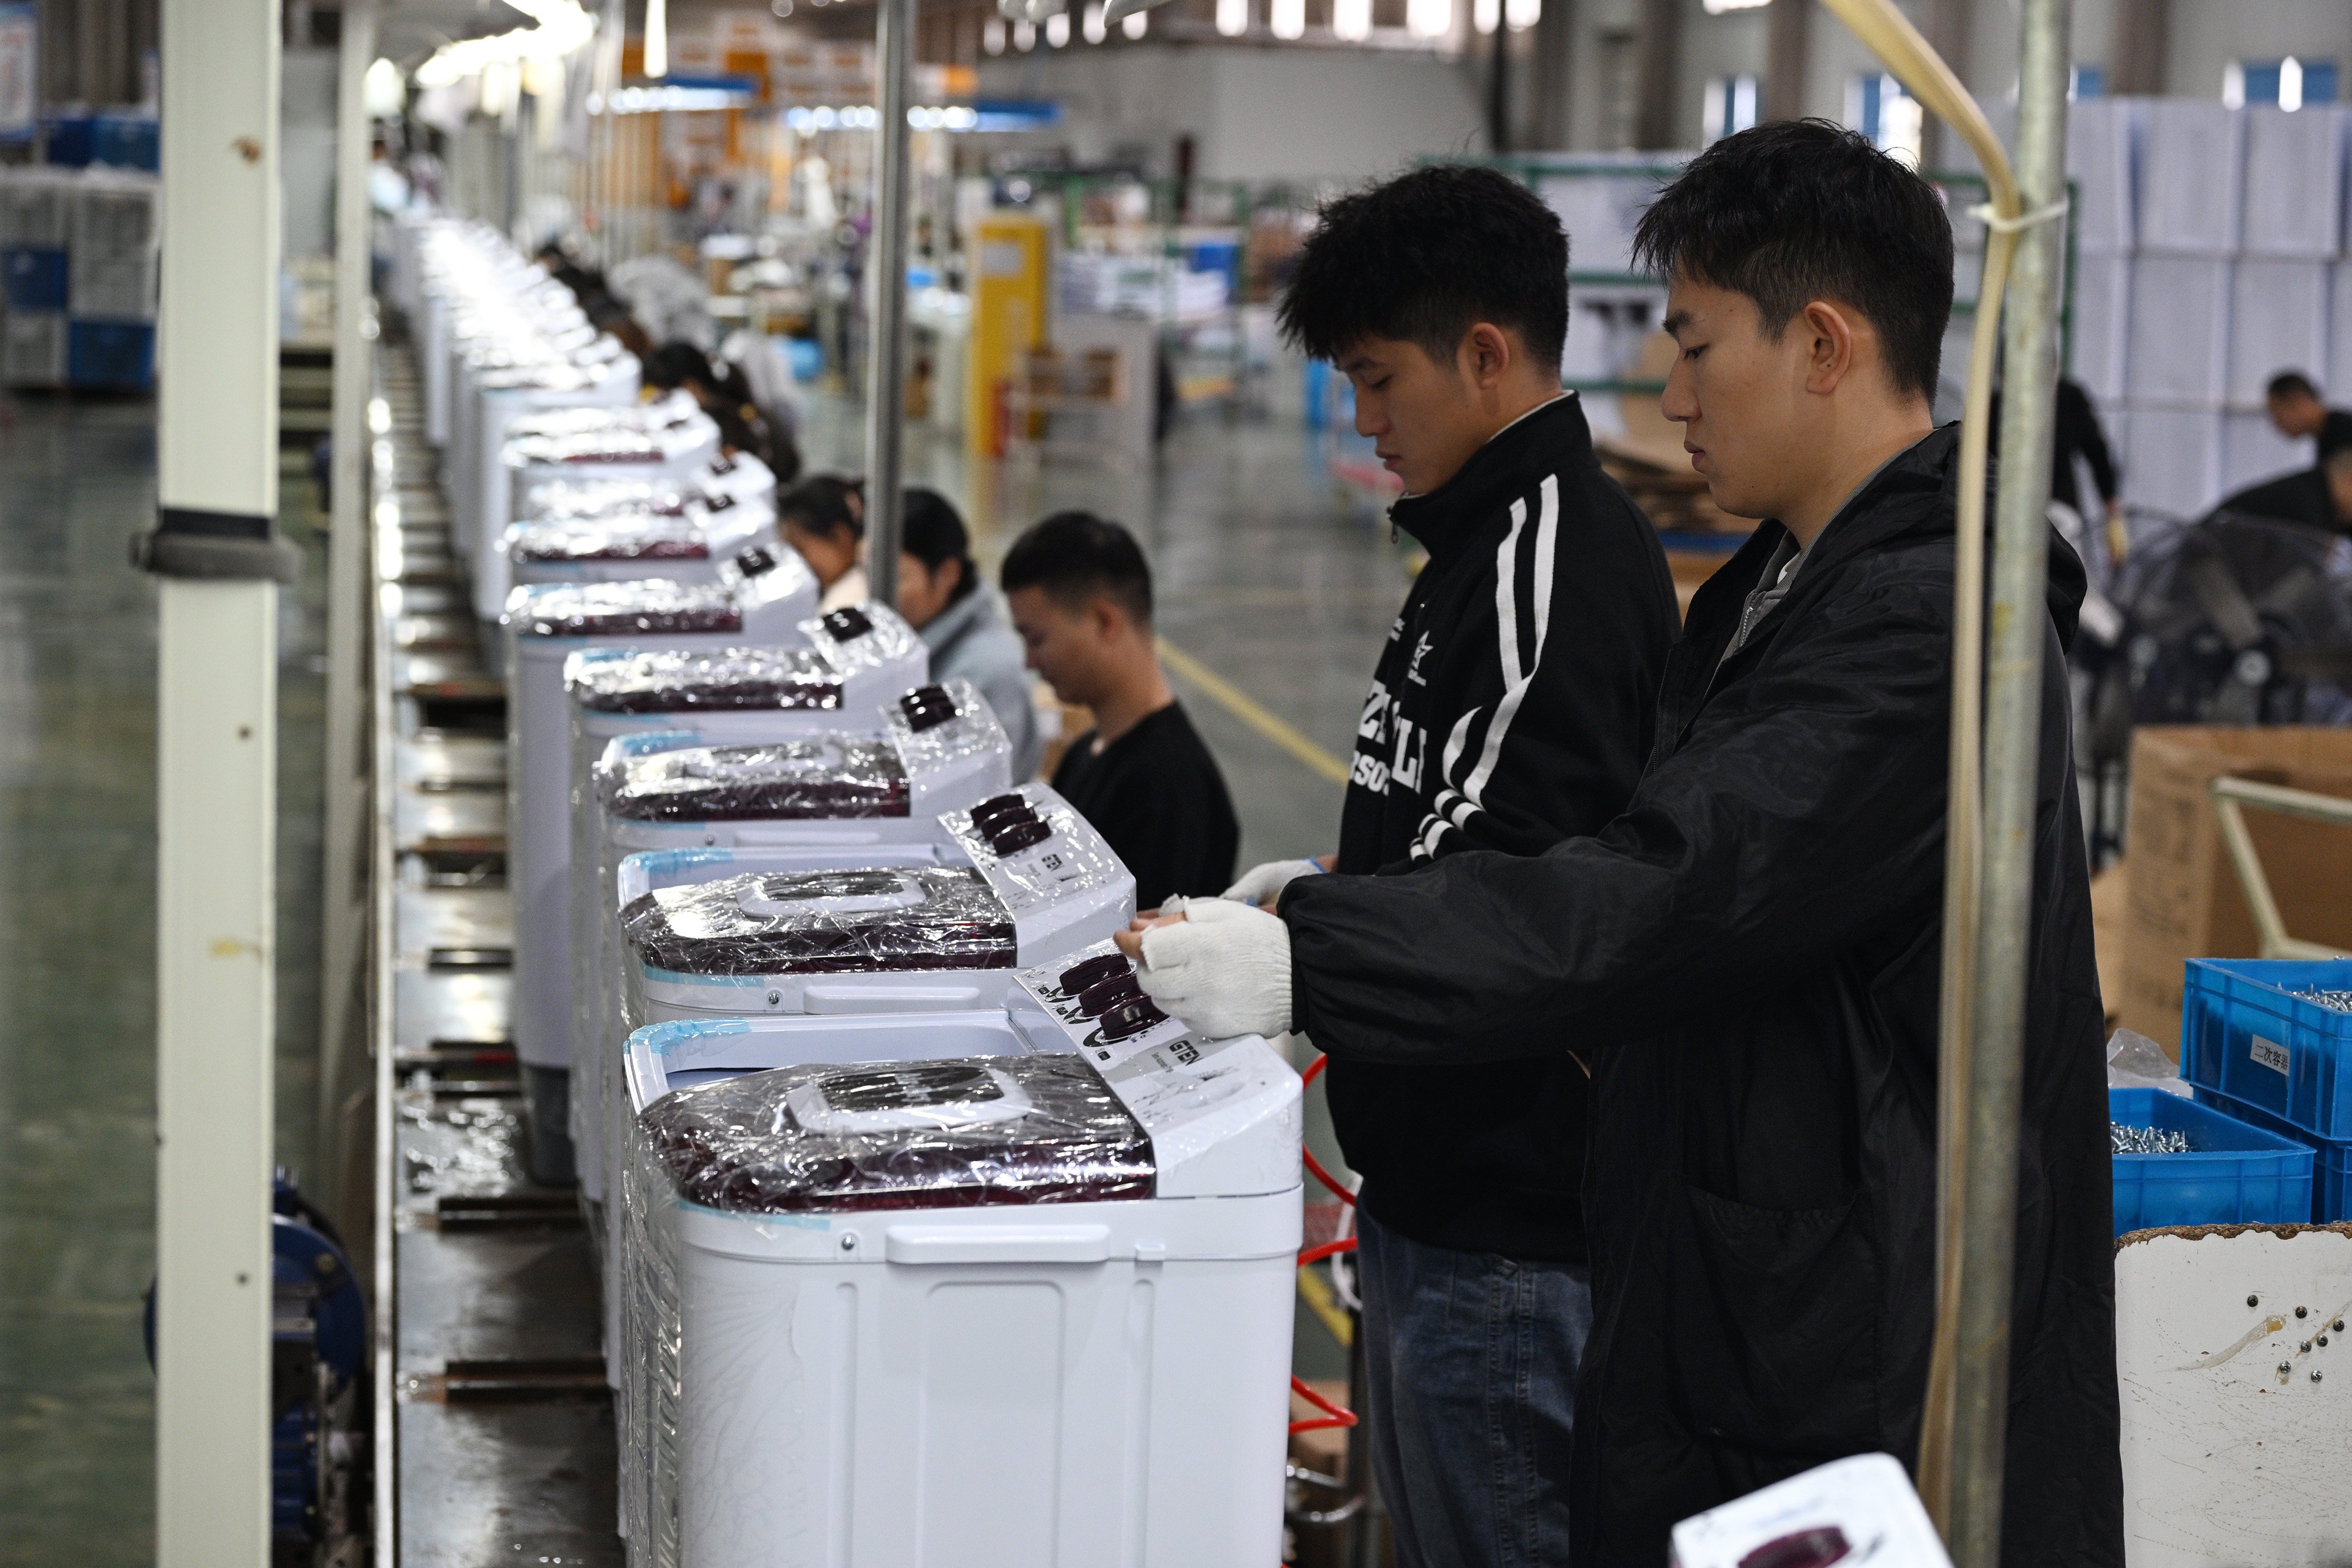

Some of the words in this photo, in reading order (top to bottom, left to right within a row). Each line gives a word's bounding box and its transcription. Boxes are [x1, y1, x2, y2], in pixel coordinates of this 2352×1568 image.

[1169, 1039, 1204, 1066] GTEN
[2254, 1045, 2289, 1070] 二次容器
